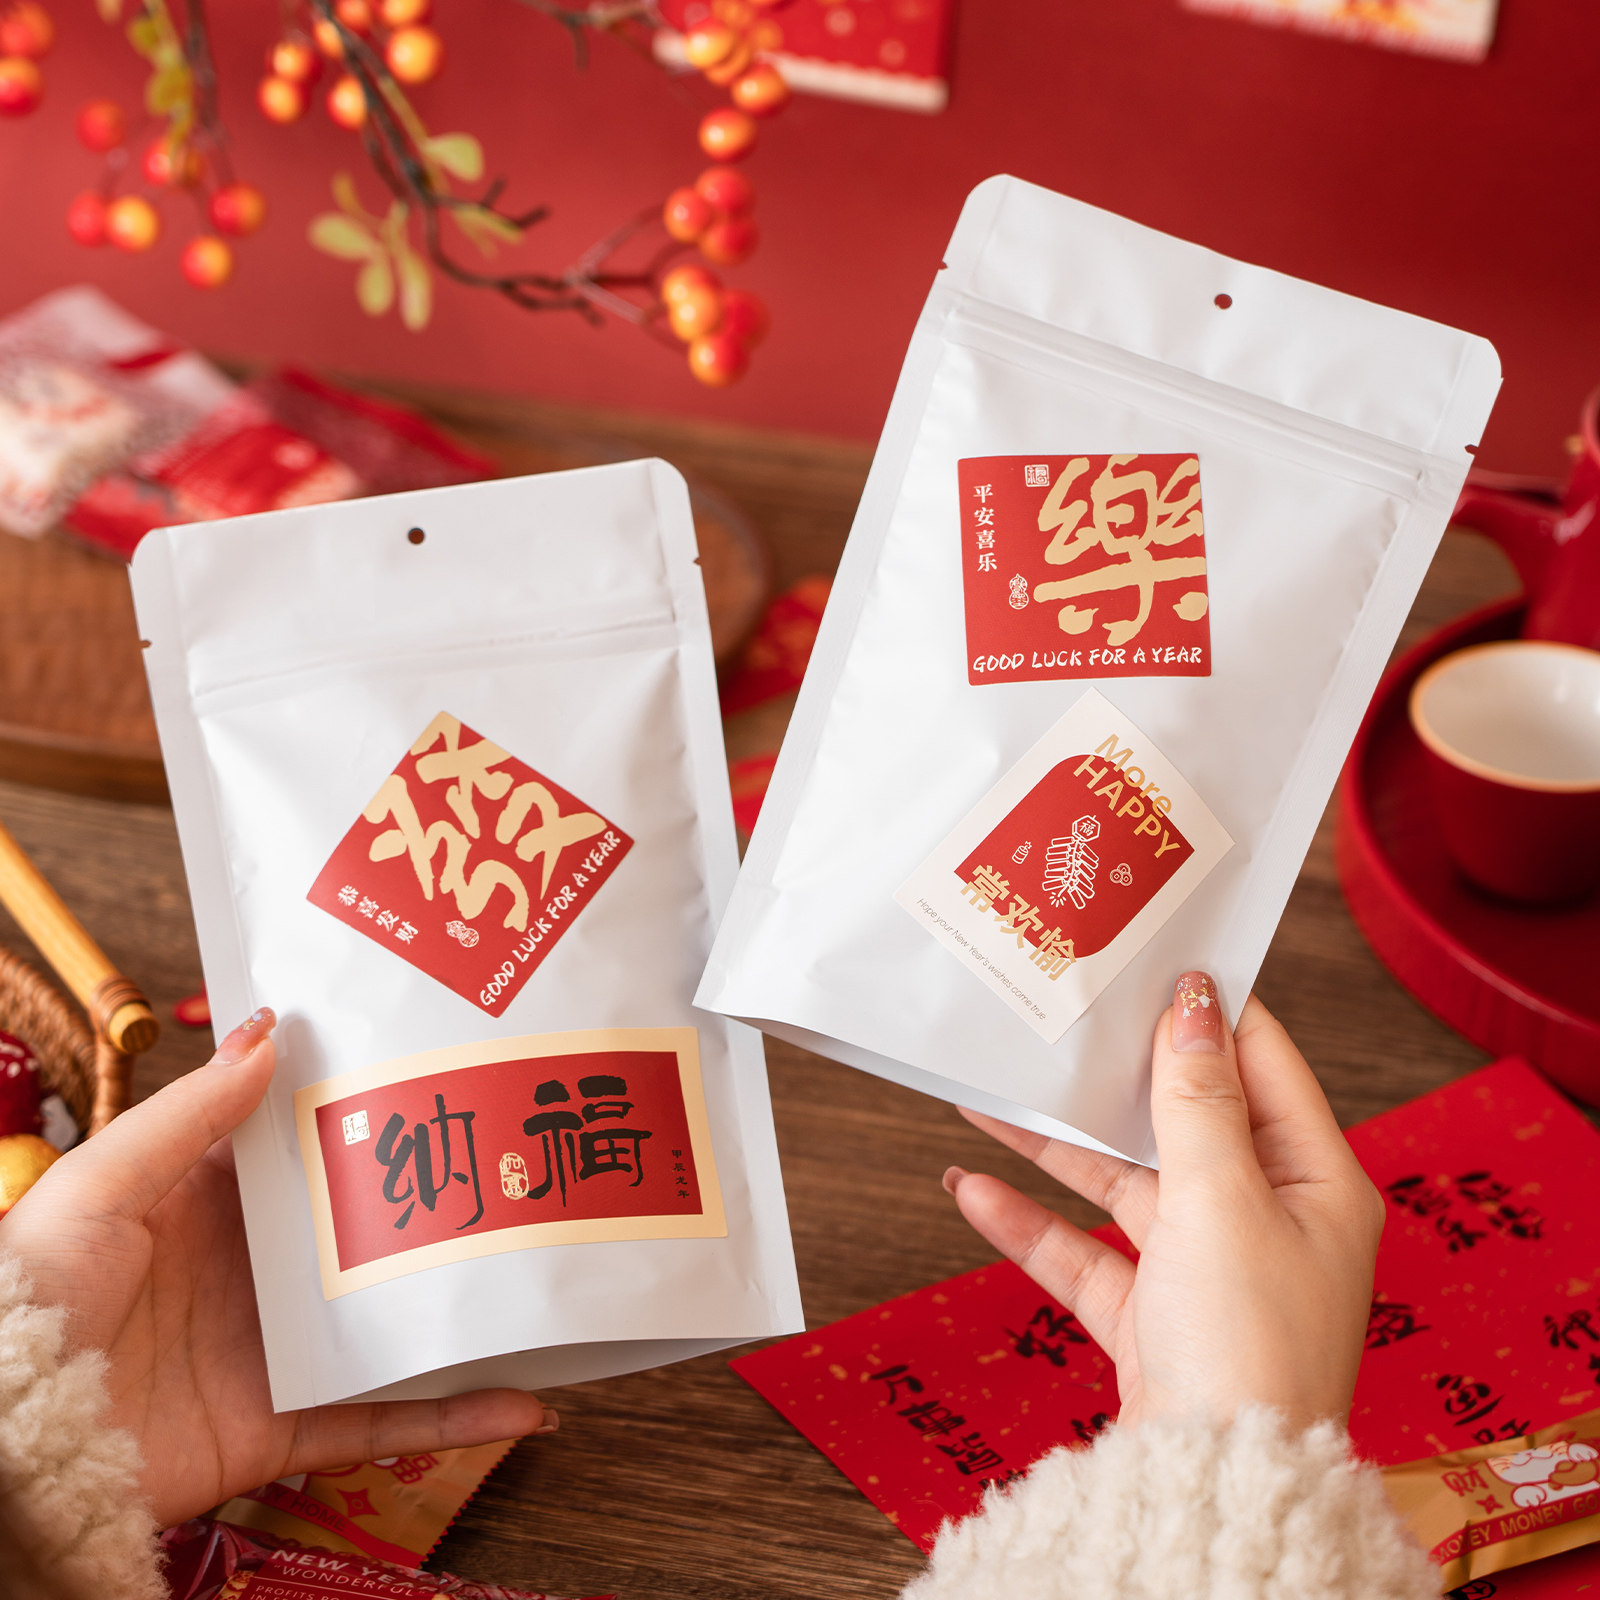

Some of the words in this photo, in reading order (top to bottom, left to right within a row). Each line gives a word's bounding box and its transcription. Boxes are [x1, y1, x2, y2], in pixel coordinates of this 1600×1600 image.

[972, 483, 998, 572] 平安喜乐
[972, 652, 1025, 673] GOOD
[1031, 649, 1083, 669] LUCK
[1088, 648, 1127, 666] FOR
[1133, 646, 1147, 664] A
[1151, 646, 1202, 664] YEAR
[1094, 733, 1172, 819] More
[1073, 755, 1181, 860] HAPPY
[1078, 819, 1097, 837] 福
[337, 884, 420, 945] 恭喜发财
[479, 960, 516, 1007] GOOD
[511, 917, 553, 964] LUCK
[545, 884, 578, 921] FOR
[572, 871, 590, 888] A
[581, 829, 622, 875] YEAR
[960, 864, 1077, 982] 常欢愉
[916, 898, 939, 919] Hope
[933, 914, 954, 934] your
[951, 929, 970, 949] New
[987, 963, 1013, 989] wishes
[1010, 986, 1033, 1008] come
[1030, 1003, 1047, 1021] true
[290, 1495, 347, 1532] HOME
[1500, 1502, 1564, 1538] MONEY
[271, 1549, 350, 1572] NEW
[255, 1585, 316, 1600] PROFITS
